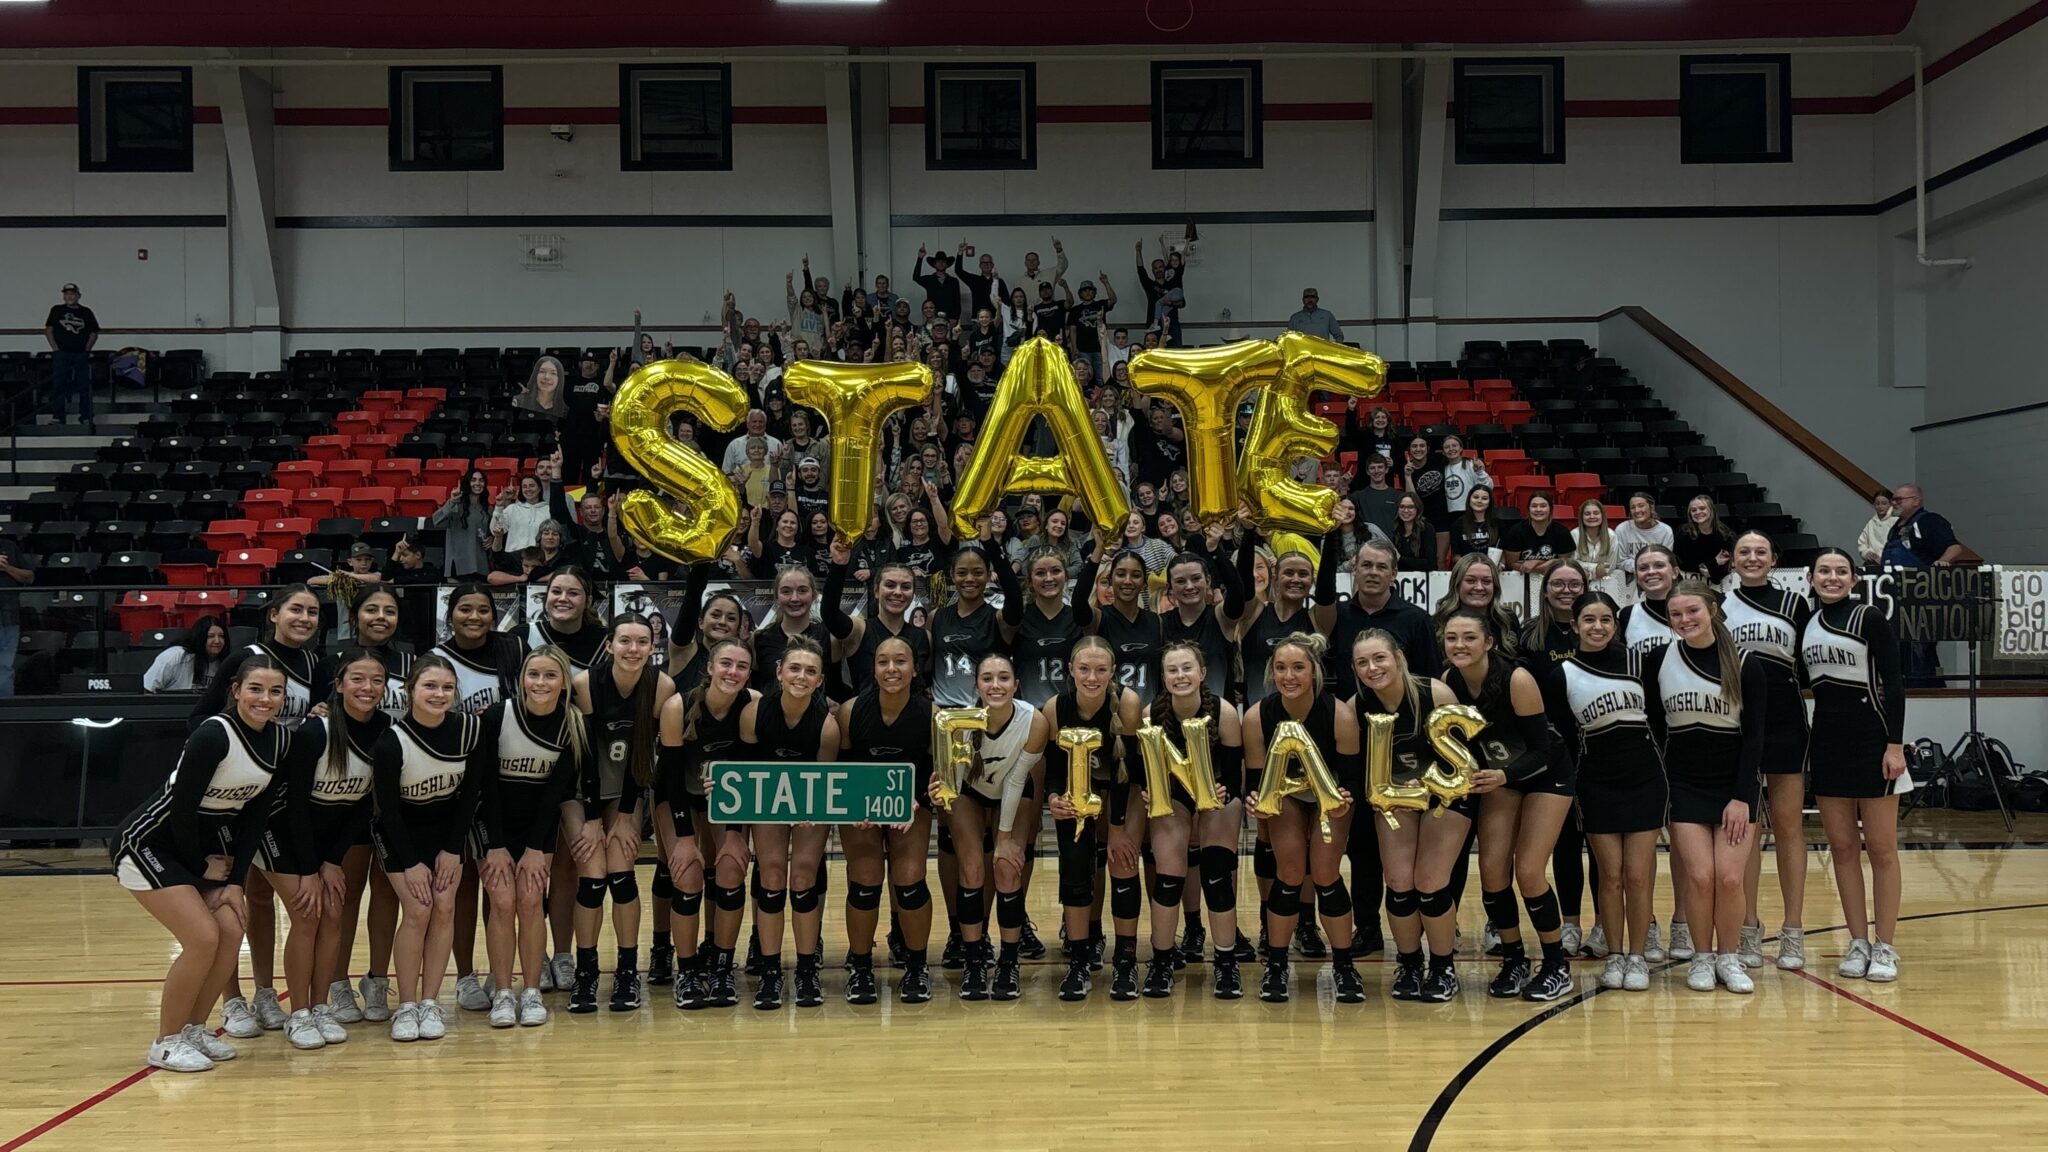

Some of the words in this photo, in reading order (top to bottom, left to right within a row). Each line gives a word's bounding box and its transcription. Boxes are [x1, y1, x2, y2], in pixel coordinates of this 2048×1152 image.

[610, 330, 1387, 564] STATE
[1902, 566, 1982, 601] Falcon
[2011, 574, 2043, 608] go
[2006, 599, 2046, 633] big
[943, 652, 974, 677] 14
[1039, 658, 1065, 682] 12
[1120, 664, 1148, 688] 21
[88, 679, 112, 690] POSS.
[1582, 691, 1644, 723] BUSHLAND
[1665, 691, 1730, 716] BUSHLAND
[609, 741, 627, 761] 8
[401, 772, 465, 798] BUSHLAN
[718, 770, 848, 815] STATE
[886, 769, 906, 791] ST
[864, 795, 905, 818] 1400
[264, 829, 281, 858] FALCONS
[140, 846, 165, 873] FALCONS
